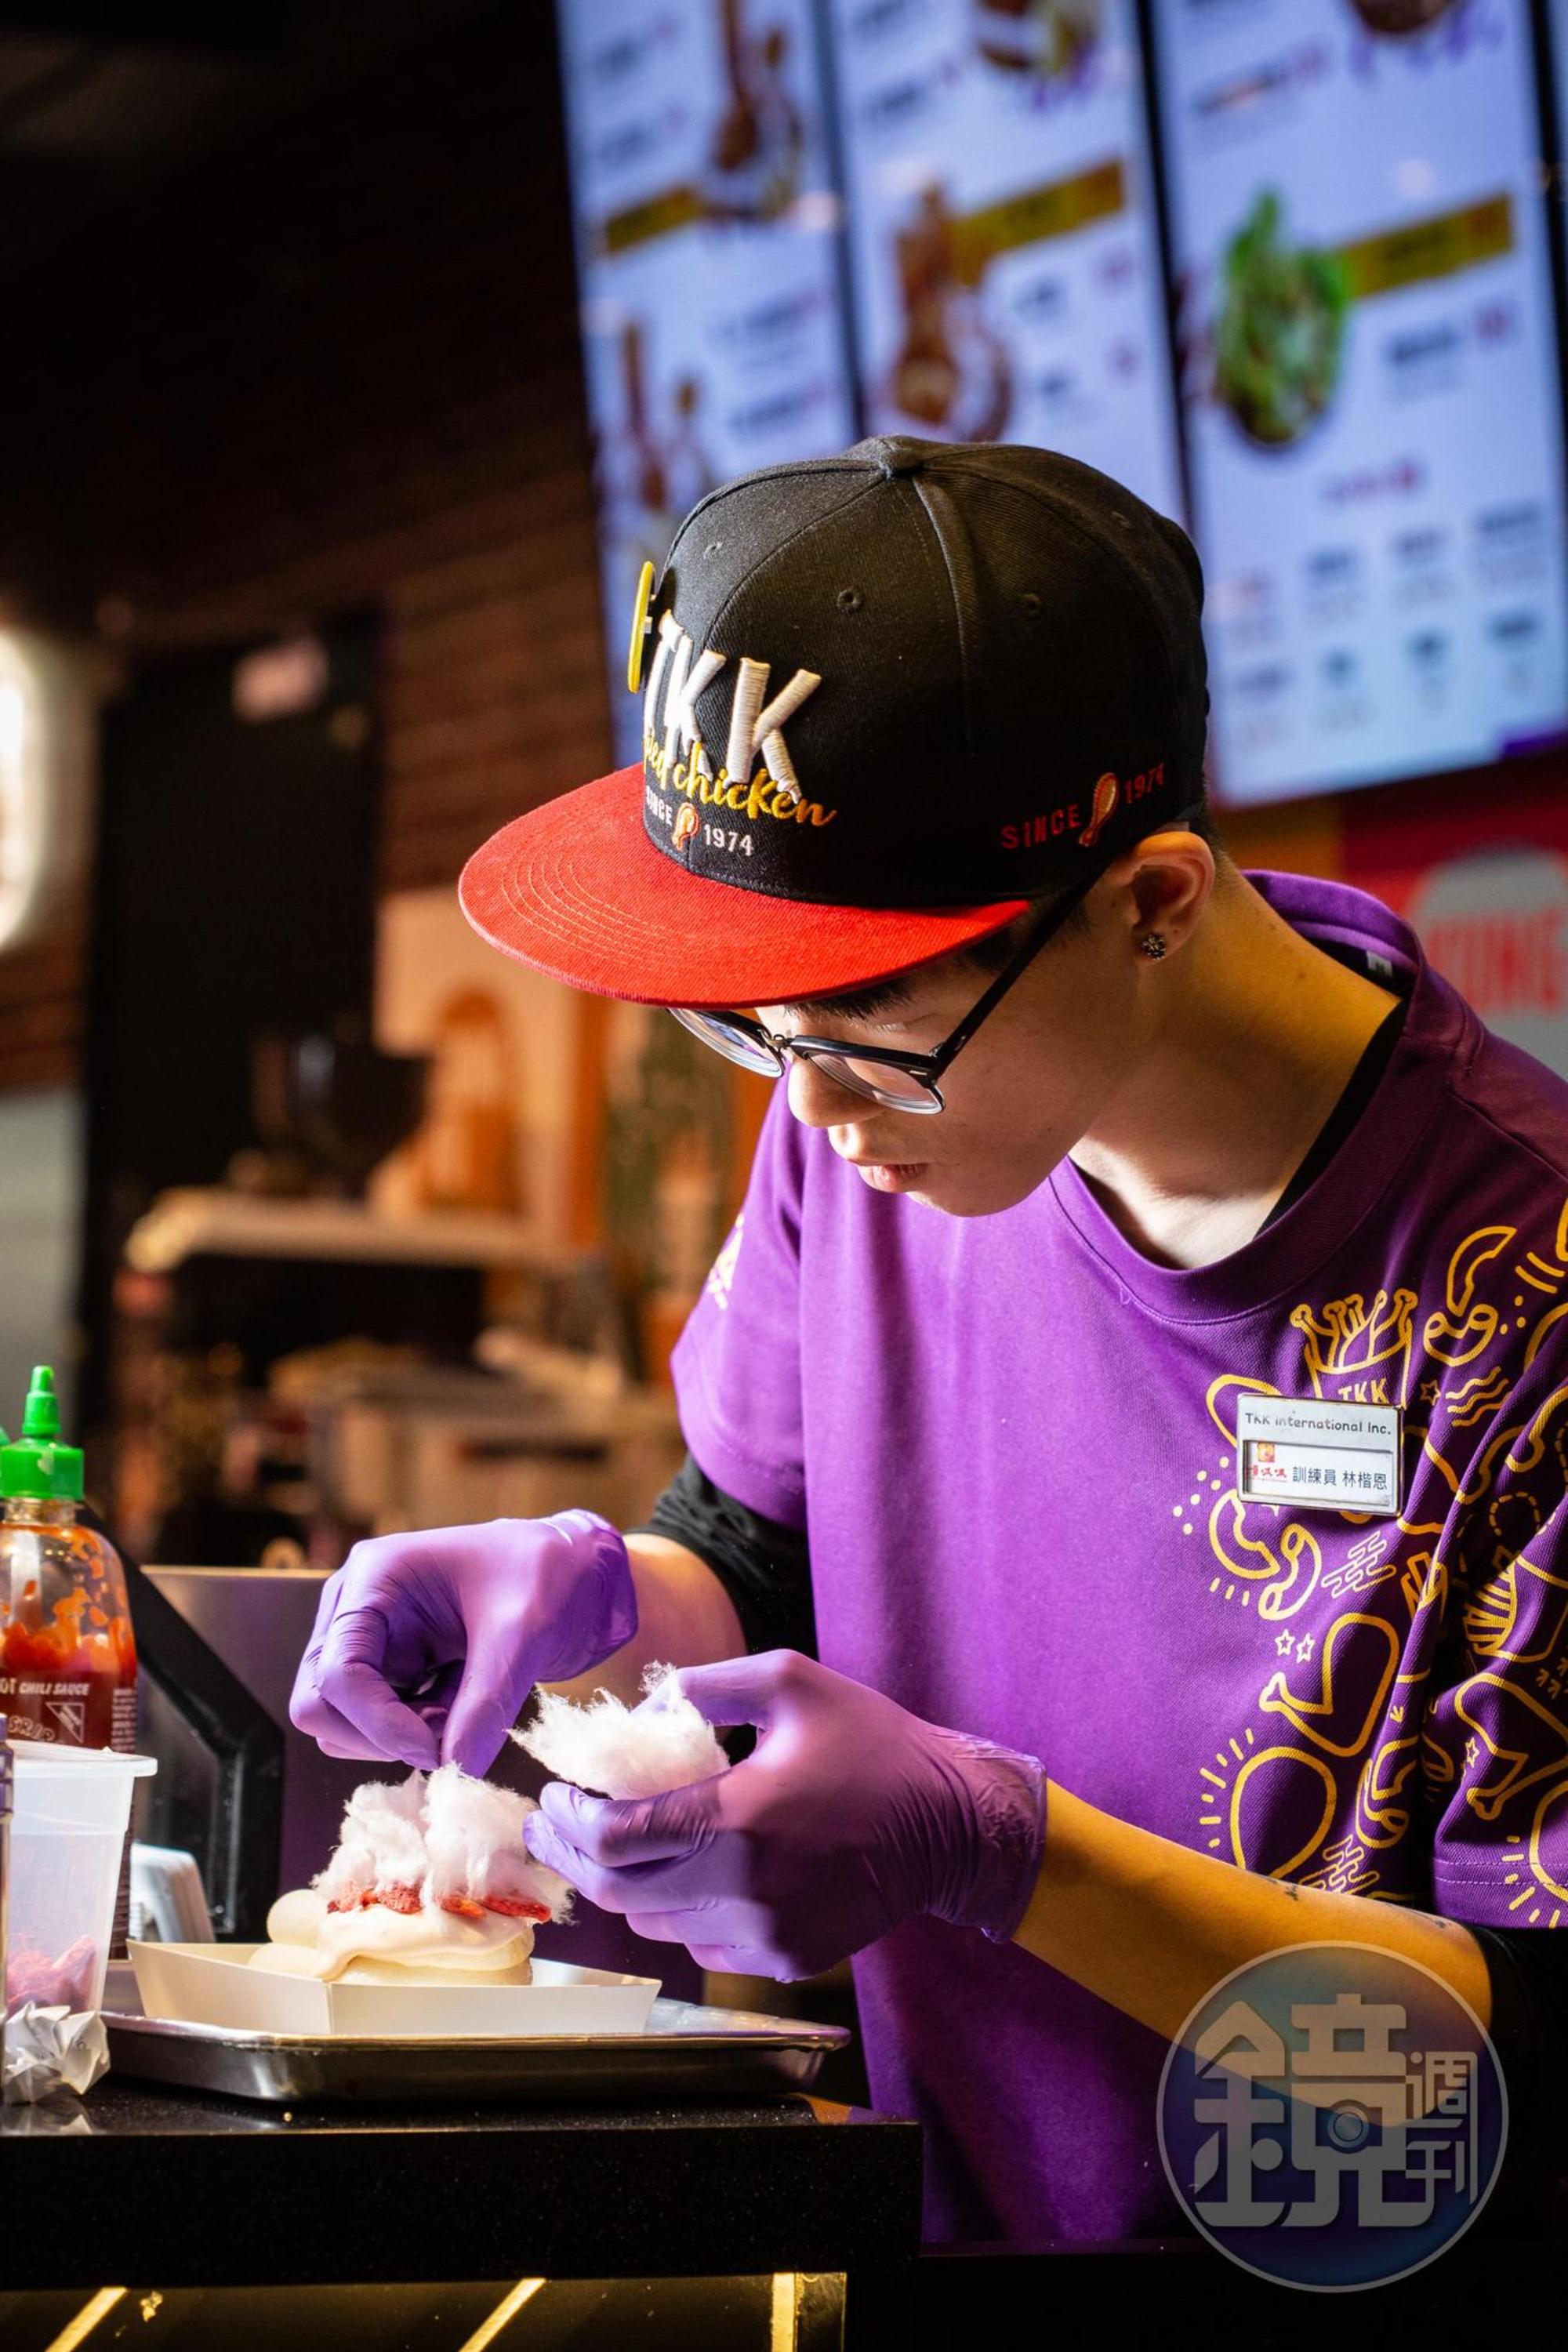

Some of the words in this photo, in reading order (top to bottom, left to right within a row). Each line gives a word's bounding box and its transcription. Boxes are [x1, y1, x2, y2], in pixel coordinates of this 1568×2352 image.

[673, 741, 838, 826] chicken
[1000, 804, 1081, 849] SINCE
[1124, 762, 1165, 804] 1974
[704, 824, 755, 857] 1974
[1338, 1377, 1389, 1403] TKK
[1367, 1421, 1392, 1436] Inc.
[1292, 1466, 1338, 1486] 訓練員
[1342, 1470, 1388, 1490] 林楷恩
[53, 1682, 89, 1696] SAUCE
